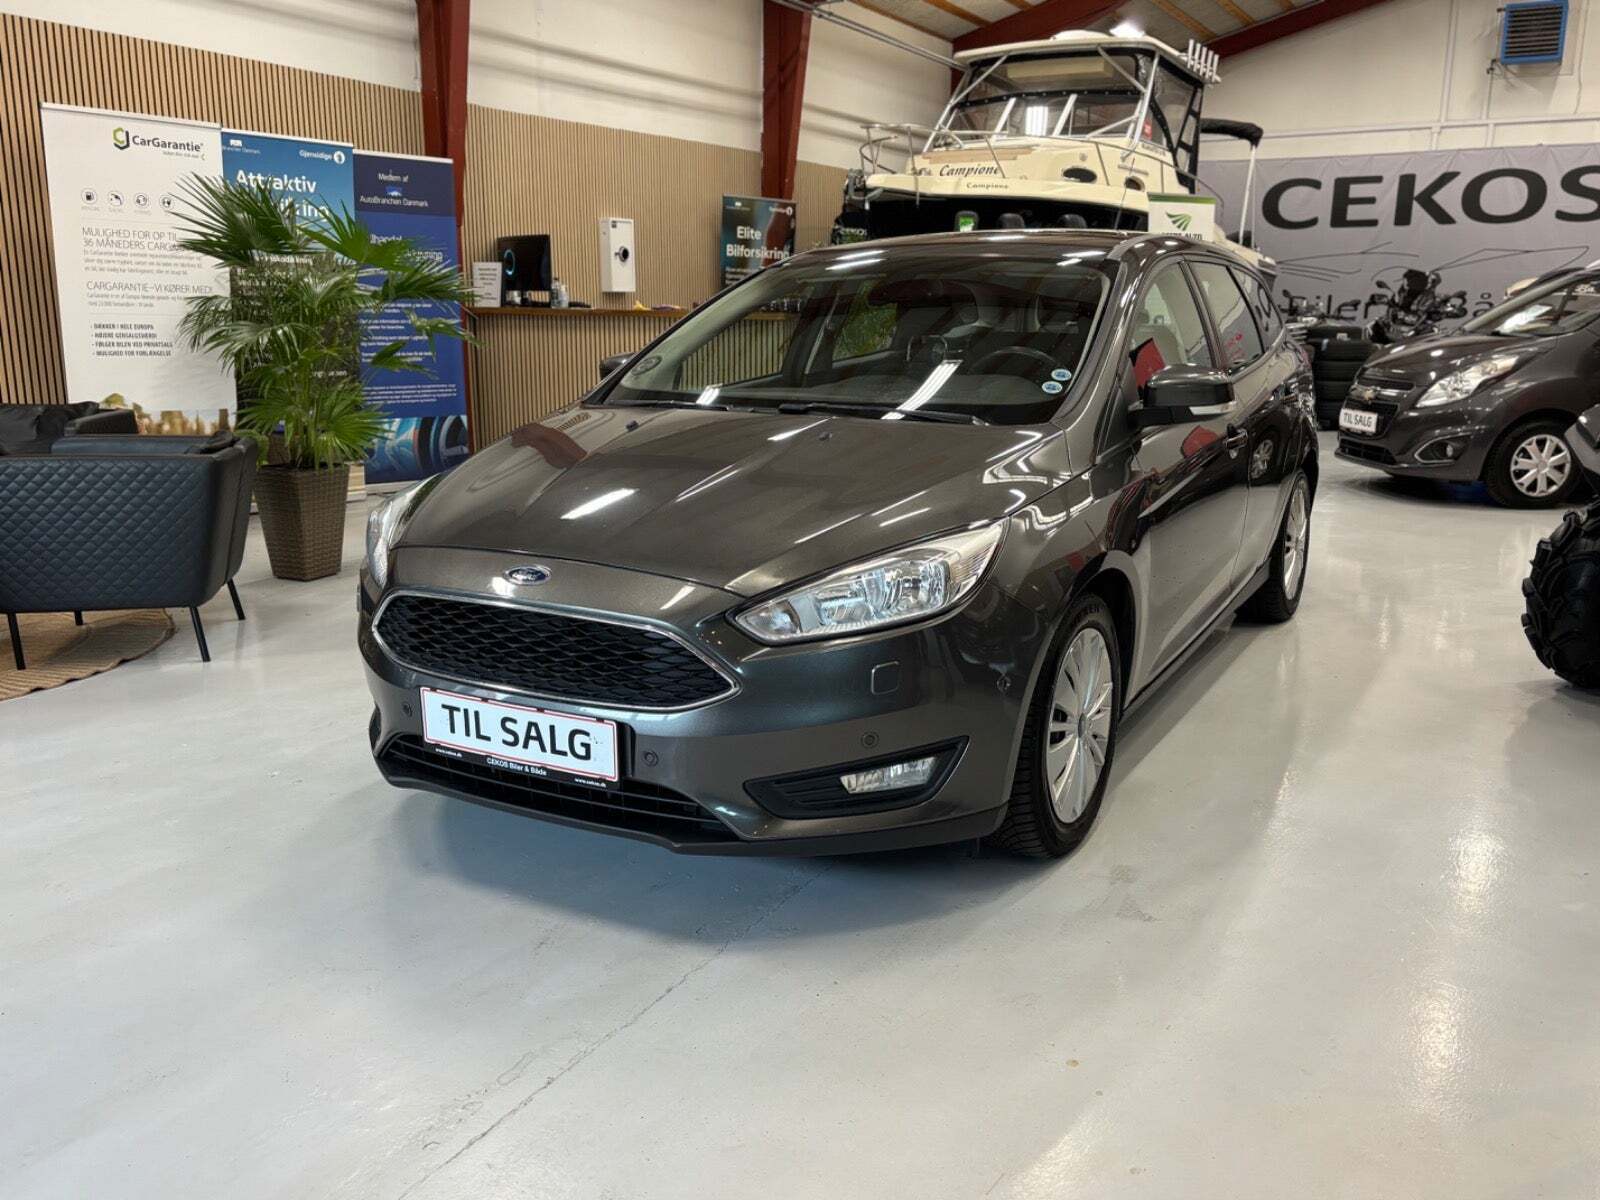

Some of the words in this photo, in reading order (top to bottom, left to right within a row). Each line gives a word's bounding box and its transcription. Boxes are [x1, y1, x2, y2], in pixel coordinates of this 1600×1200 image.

[132, 135, 202, 152] CarGarantie
[1262, 165, 1600, 230] CEKOS
[736, 225, 762, 240] Elite
[1354, 414, 1373, 428] SALG
[441, 703, 491, 742] TIL
[500, 716, 591, 761] SALG
[486, 757, 508, 769] CEKOS
